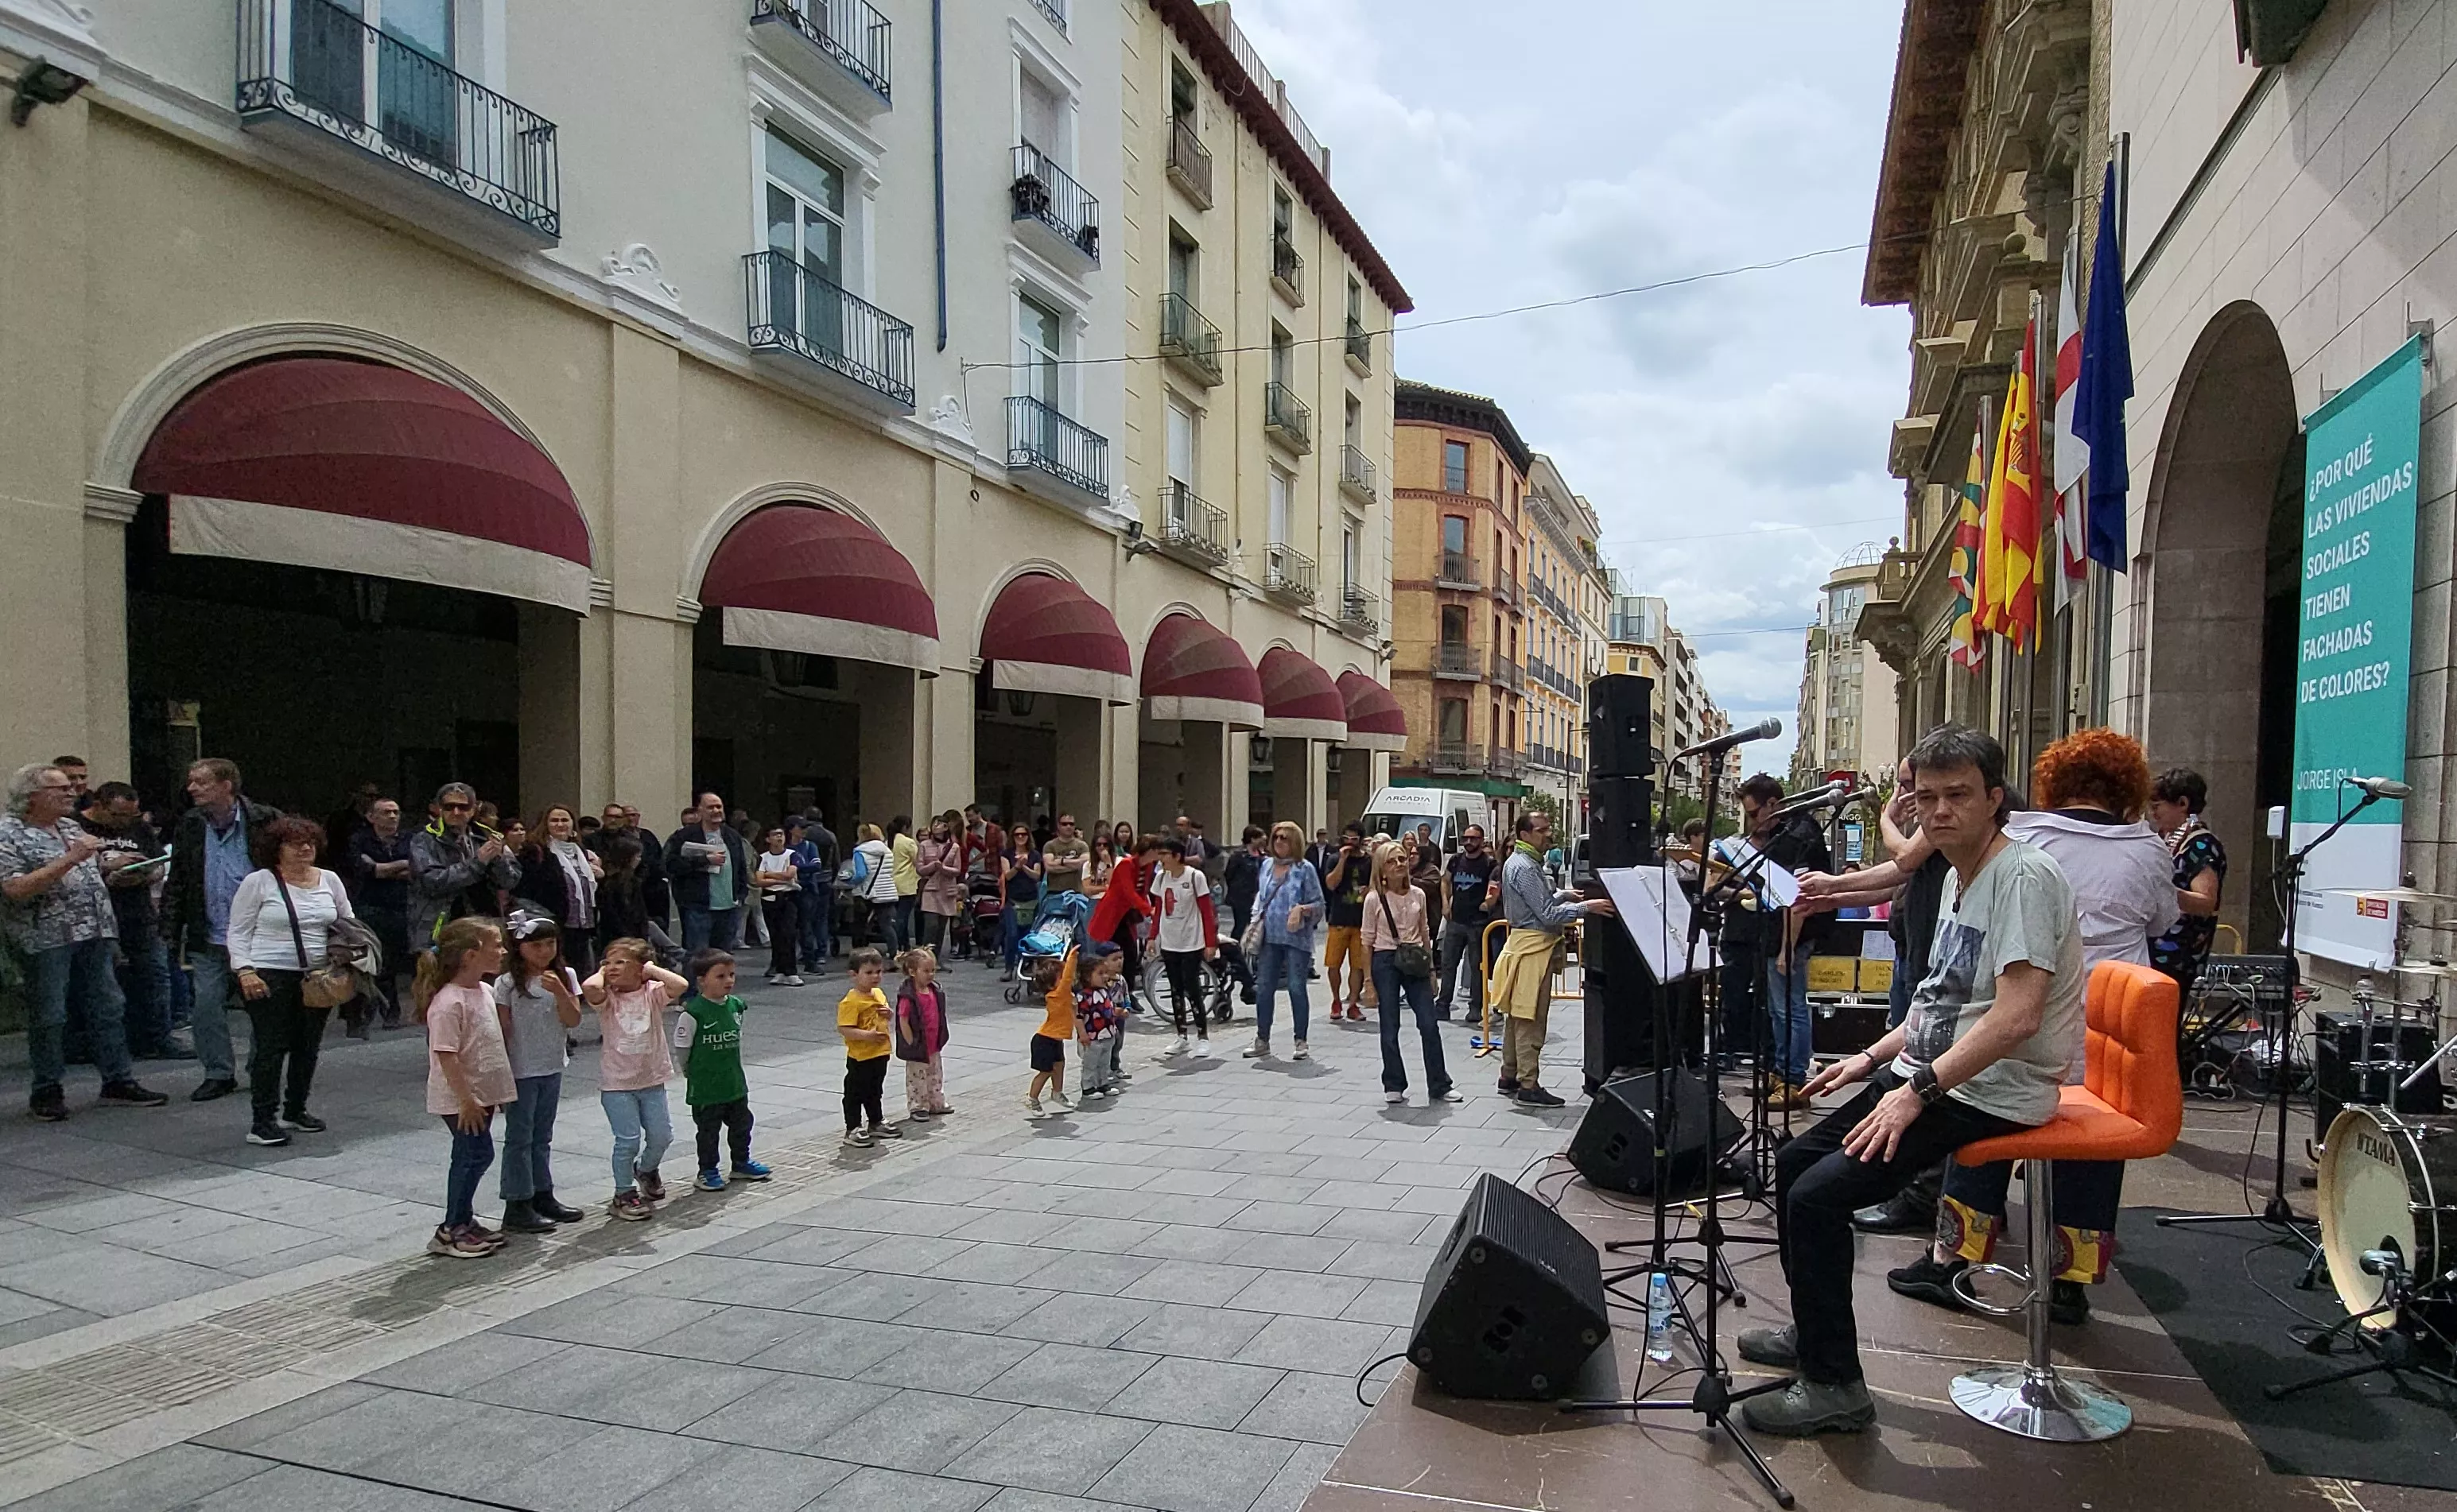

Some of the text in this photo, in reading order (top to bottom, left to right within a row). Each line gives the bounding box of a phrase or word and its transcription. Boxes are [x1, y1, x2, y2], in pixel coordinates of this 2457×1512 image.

[2309, 433, 2374, 502] ¿POR QUÉ
[2308, 461, 2413, 539] LAS VIVIENDAS
[2306, 531, 2370, 580] SOCIALES
[2305, 583, 2350, 621] TIENEN
[2303, 620, 2373, 662] FACHADAS
[2301, 661, 2390, 703] DE COLORES?
[2297, 769, 2331, 789] JORGE
[2358, 1133, 2395, 1166] TAMA
